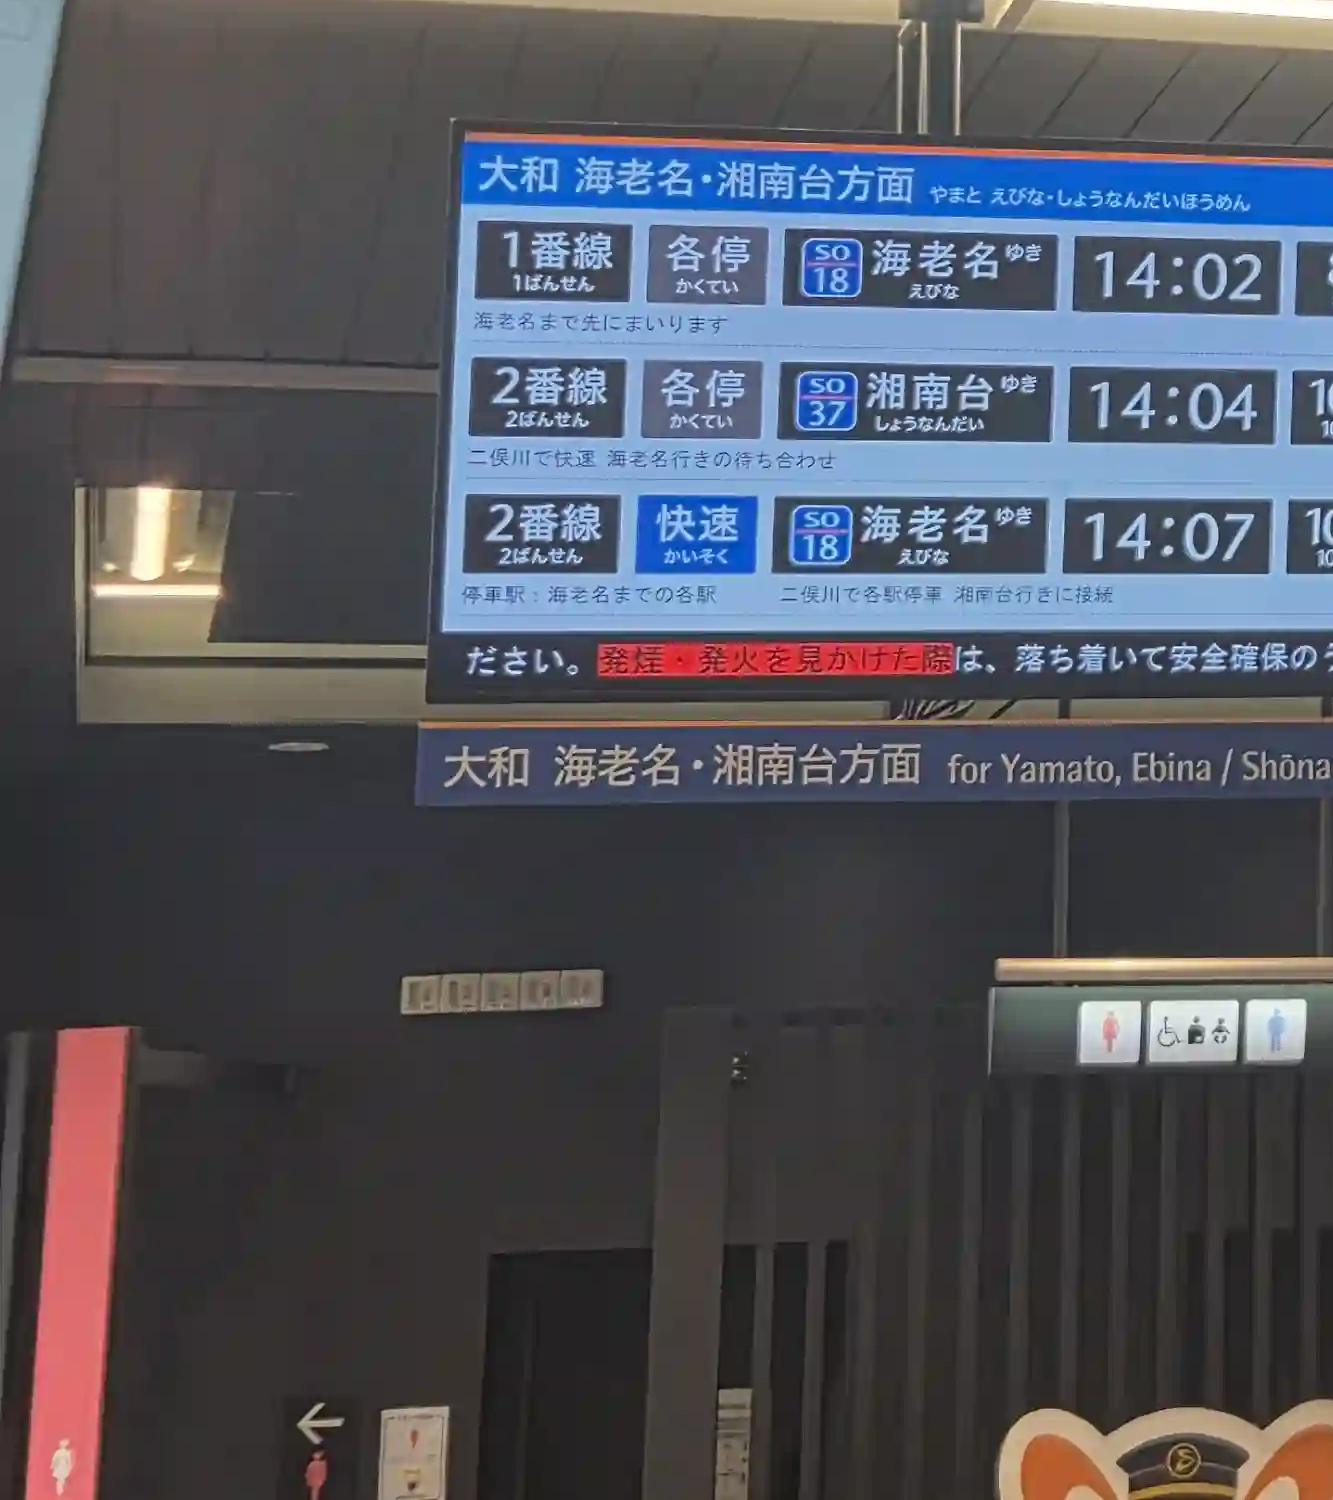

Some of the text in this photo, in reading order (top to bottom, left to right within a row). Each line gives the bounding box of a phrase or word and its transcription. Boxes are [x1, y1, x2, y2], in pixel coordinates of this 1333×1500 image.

[479, 157, 1251, 214] 大和 海老名・湘南台方面 やまと えびな・しょうなんだいほうめん
[501, 231, 613, 269] 1番線
[666, 233, 751, 273] 各停
[814, 243, 851, 262] SO
[871, 240, 1042, 279] 海老名 ゆき
[512, 273, 596, 295] 1ばんせん
[674, 277, 740, 297] かくてい
[814, 266, 848, 294] 18
[1095, 250, 1263, 302] 14:02
[908, 282, 959, 301] えびな
[473, 311, 729, 336] 海老名まで先にまいります
[491, 366, 609, 407] 2番線
[661, 368, 746, 408] 各停
[809, 376, 846, 396] SO
[866, 373, 1038, 411] 湘南台 ゆき
[505, 409, 590, 430] 2ばんせん
[669, 411, 734, 430] かくてい
[808, 400, 846, 429] 37
[1089, 381, 1259, 432] 14:04
[874, 413, 986, 434] しょうなんだい
[467, 447, 838, 471] 二俣川で快速 海老名行きの待ち合わせ
[485, 503, 603, 545] 2番線
[657, 504, 740, 544] 快速
[803, 510, 840, 530] SO
[861, 505, 1033, 545] 海老名 ゆき
[803, 533, 839, 562] 18
[1084, 512, 1256, 563] 14:07
[499, 546, 583, 567] 2ばんせん
[663, 547, 729, 566] かいそく
[898, 547, 950, 567] えびな
[780, 583, 942, 606] 二俣川で各駅停車
[954, 583, 1114, 606] 湘南台行きに接続
[444, 746, 529, 787] 大和
[554, 744, 920, 788] 海老名・湘南台方面
[947, 757, 992, 785] for
[1002, 754, 1122, 788] Yamato,
[1133, 751, 1212, 782] Ebina
[1220, 749, 1233, 788] /
